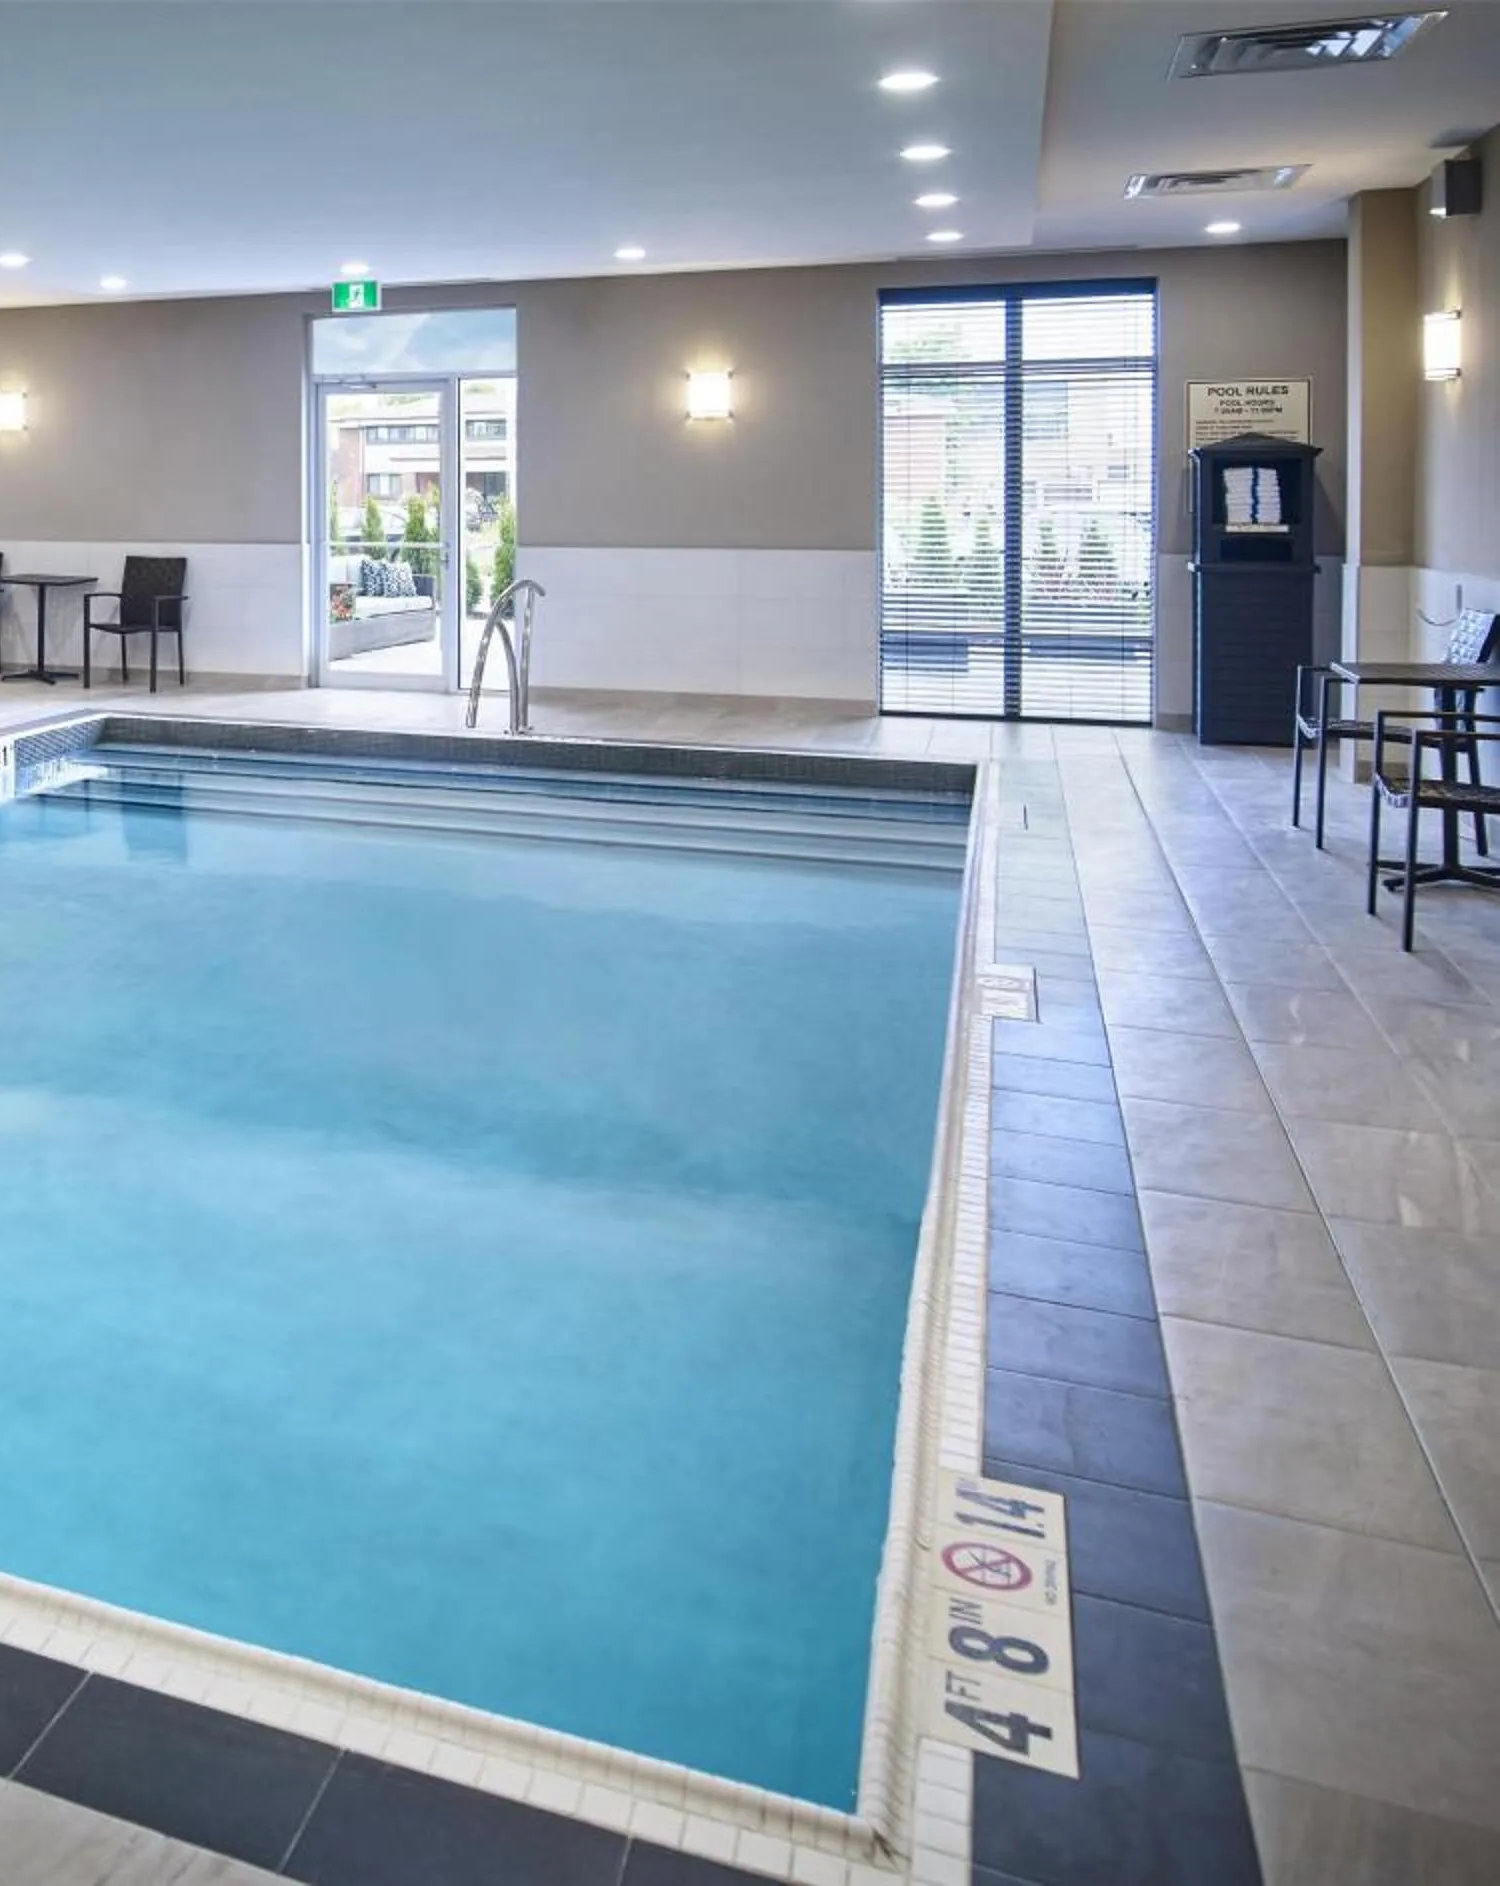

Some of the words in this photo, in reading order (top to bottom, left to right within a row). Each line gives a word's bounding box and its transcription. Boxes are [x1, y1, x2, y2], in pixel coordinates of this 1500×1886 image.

[1207, 387, 1243, 397] POOL
[1246, 385, 1289, 395] RULES
[954, 1487, 1046, 1540] 1.4
[947, 1596, 983, 1626] IN
[947, 1625, 1050, 1675] 8
[945, 1669, 981, 1702] FT
[944, 1699, 1054, 1756] 4
